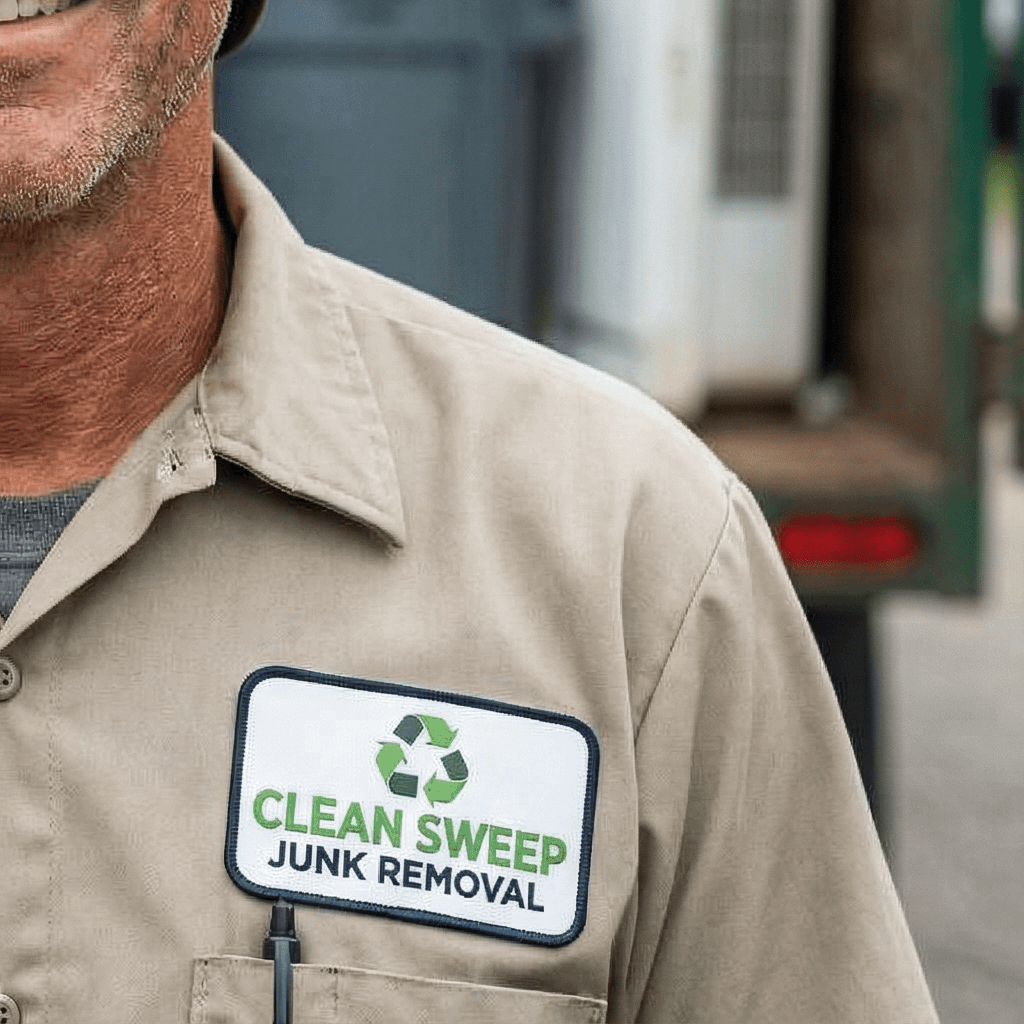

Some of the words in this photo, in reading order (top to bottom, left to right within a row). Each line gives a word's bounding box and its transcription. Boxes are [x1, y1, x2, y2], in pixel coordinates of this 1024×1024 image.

[253, 789, 403, 848] CLEAN
[416, 814, 567, 876] SWEEP
[268, 840, 368, 880] JUNK
[378, 856, 544, 912] REMOVAL
